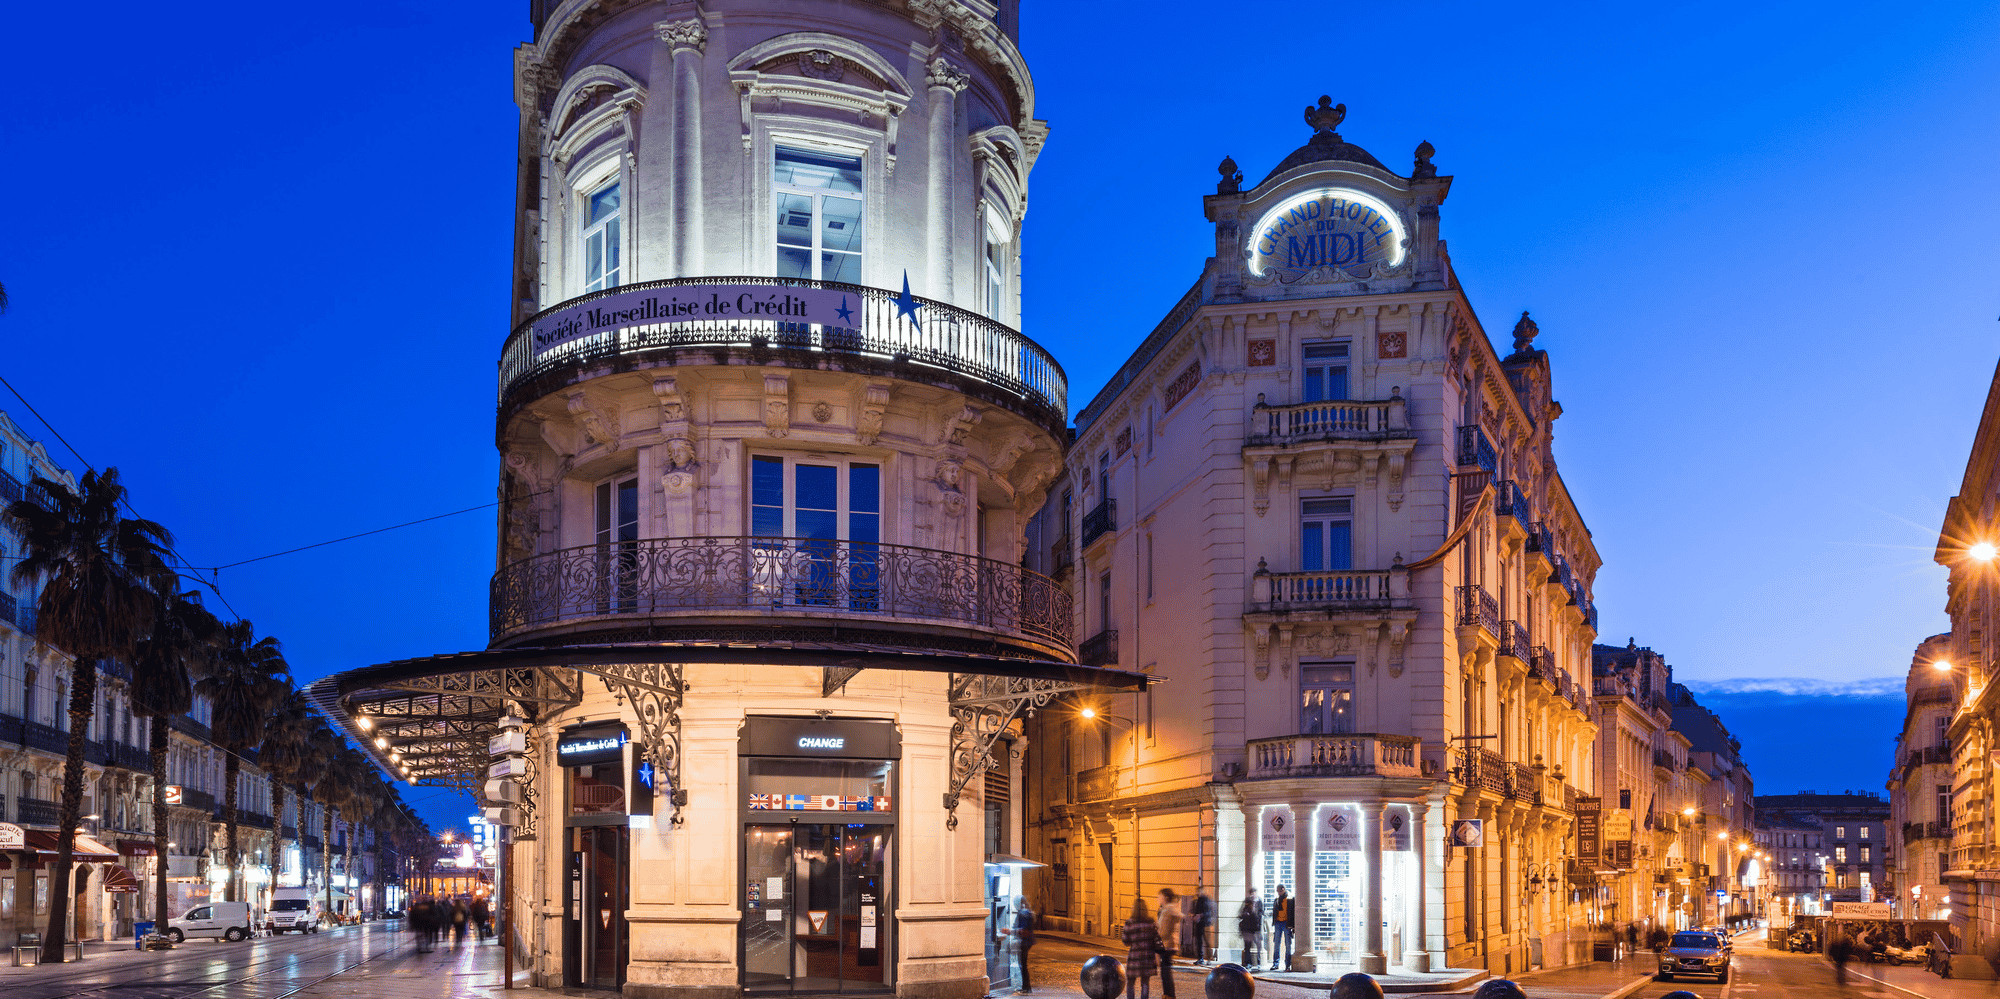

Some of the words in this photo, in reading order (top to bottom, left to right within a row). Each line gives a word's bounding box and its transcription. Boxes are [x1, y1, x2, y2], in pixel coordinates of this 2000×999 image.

[1258, 200, 1321, 256] GRAND
[1330, 198, 1393, 246] HOTEL
[1316, 219, 1336, 231] DU
[1287, 231, 1369, 267] MIDI
[535, 314, 582, 350] Société
[586, 297, 699, 326] Marseillaise
[704, 293, 731, 315] de
[736, 292, 808, 317] Crédit
[798, 737, 844, 748] CHANGE
